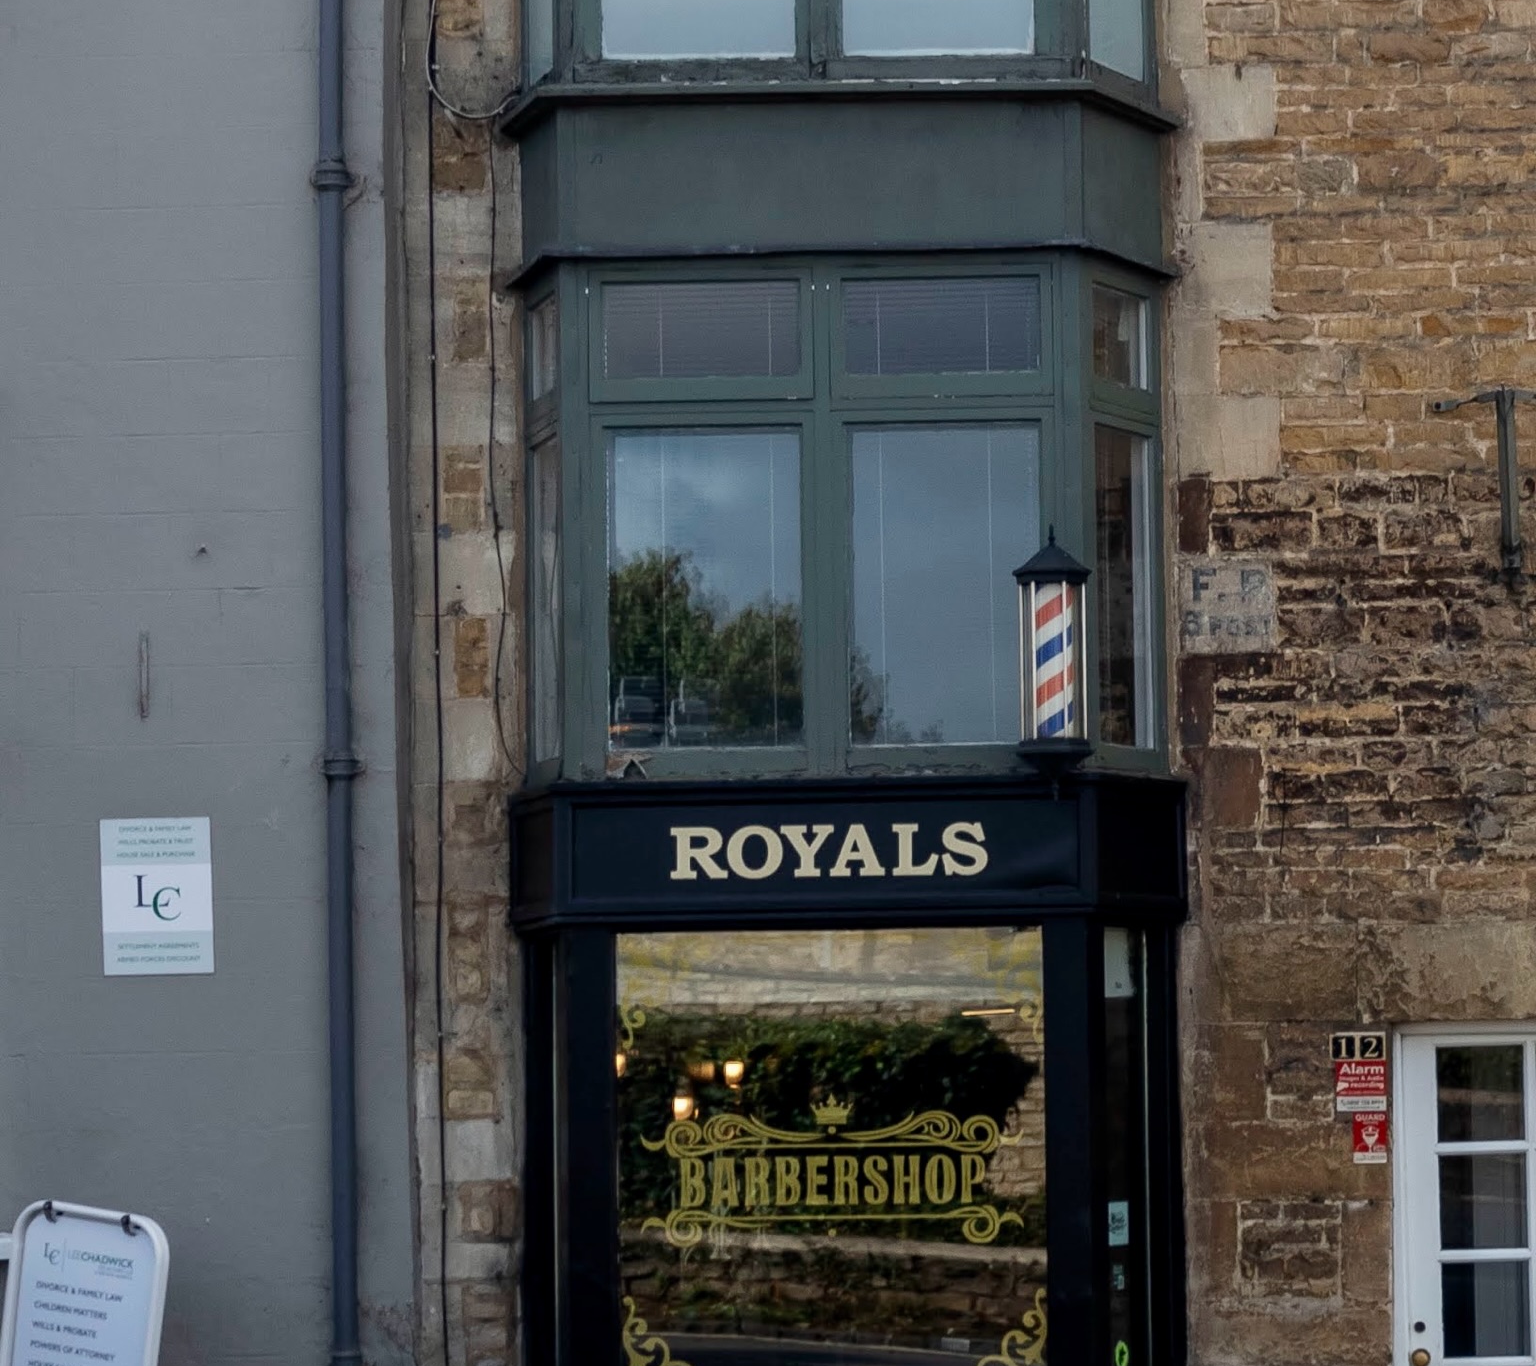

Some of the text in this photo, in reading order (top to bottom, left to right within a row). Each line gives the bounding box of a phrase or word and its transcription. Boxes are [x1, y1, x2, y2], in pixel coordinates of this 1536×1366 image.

[670, 822, 988, 880] ROYALS
[1340, 1063, 1384, 1075] Alarm
[1350, 1081, 1385, 1091] recording
[1355, 1113, 1386, 1122] GUARD
[680, 1154, 986, 1208] BARBERSHOP
[36, 1281, 69, 1294] DIVORCE
[78, 1287, 103, 1299] FAMILY
[105, 1293, 123, 1302] LAW
[34, 1301, 108, 1320] CHILDREN MATTERS
[32, 1320, 54, 1331] WILLS
[63, 1325, 97, 1338] PROBATE
[30, 1340, 61, 1352] POWERS
[75, 1348, 116, 1361] ATTORNEY
